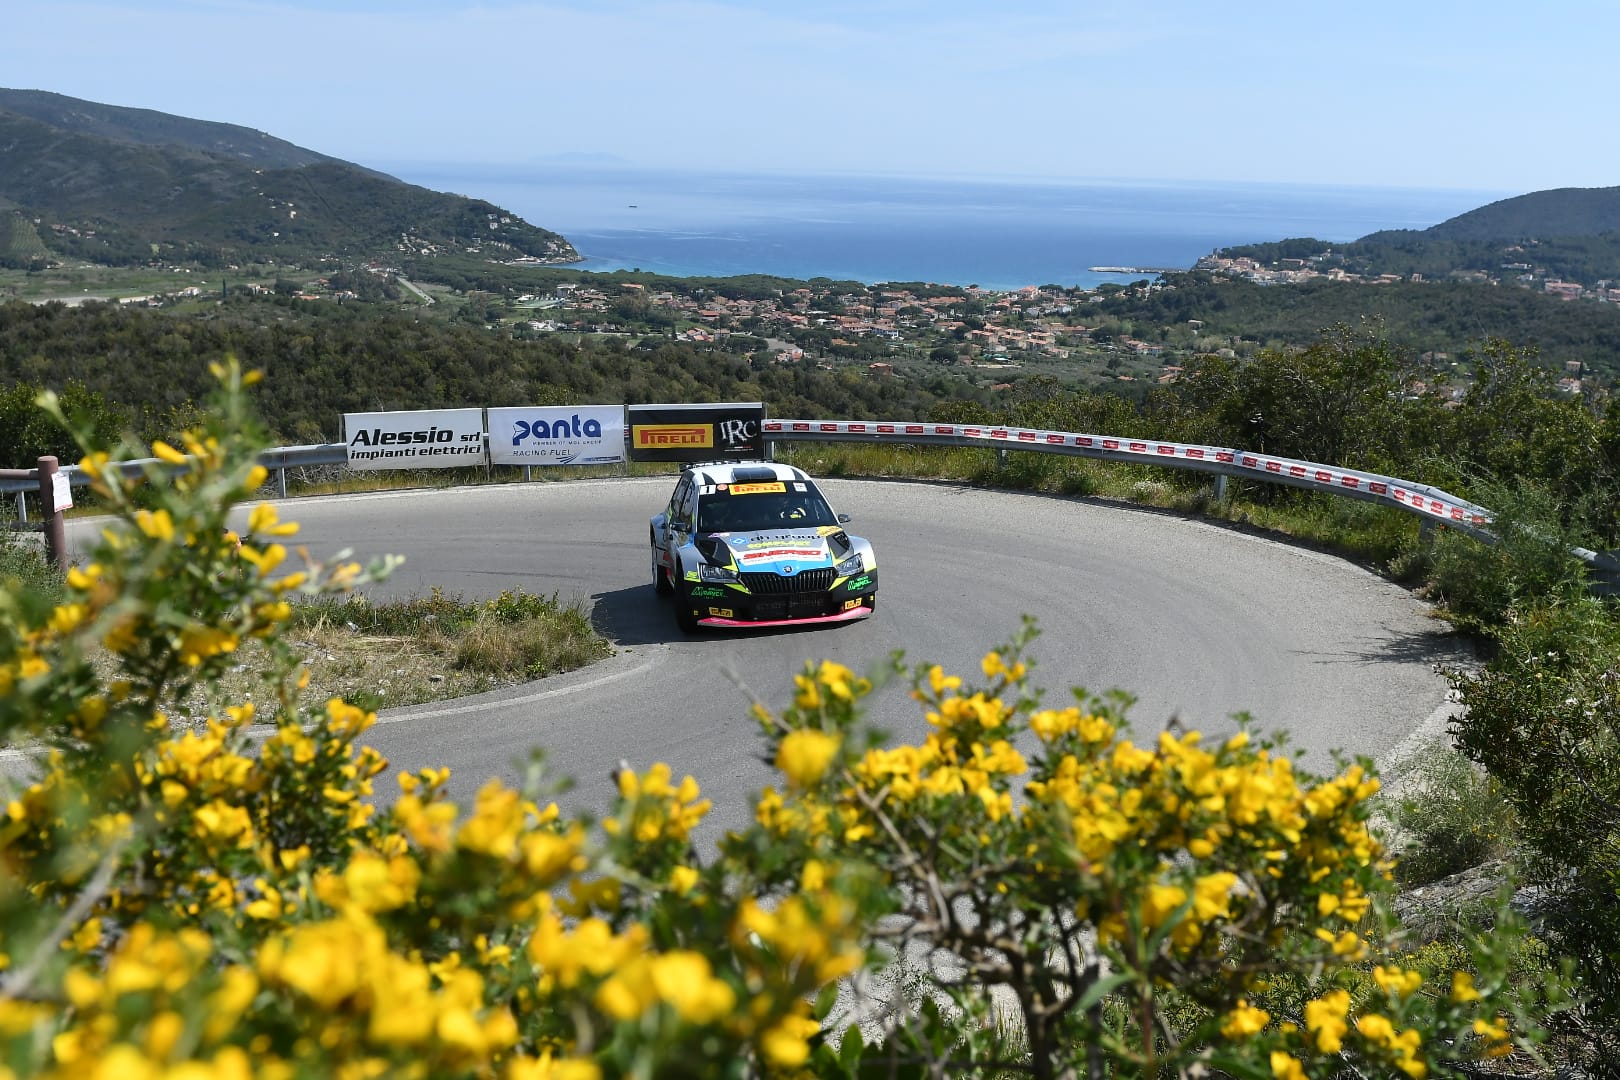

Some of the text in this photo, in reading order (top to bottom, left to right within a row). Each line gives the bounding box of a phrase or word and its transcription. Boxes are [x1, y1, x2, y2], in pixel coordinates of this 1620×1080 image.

[350, 426, 481, 447] Alessio srl
[512, 414, 602, 446] panta
[639, 428, 706, 445] PIRELLI
[350, 444, 481, 460] impianti elettrici
[512, 449, 547, 457] RACING
